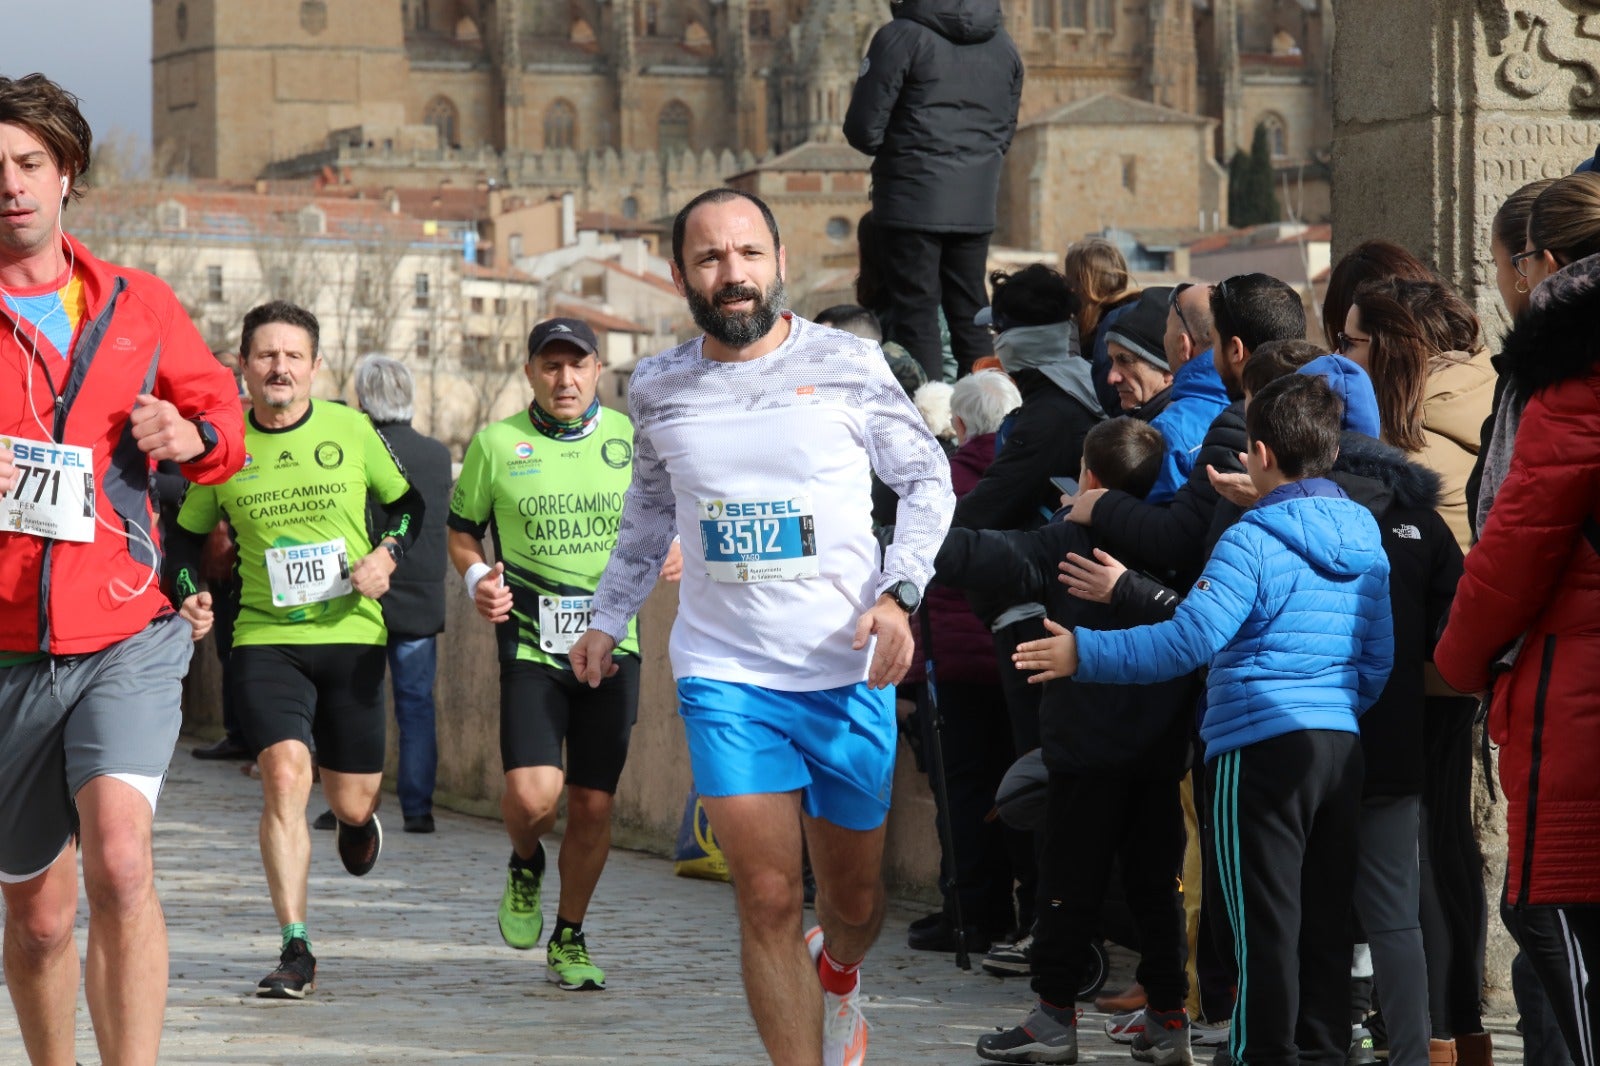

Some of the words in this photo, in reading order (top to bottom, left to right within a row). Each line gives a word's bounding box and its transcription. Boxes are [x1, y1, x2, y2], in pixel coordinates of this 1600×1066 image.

[13, 444, 85, 468] SETEL
[2, 464, 61, 506] 771
[236, 483, 347, 507] CORRECAMINOS
[18, 501, 36, 511] FER
[249, 498, 337, 520] CARBAJOSA
[725, 500, 801, 517] SETEL
[265, 514, 328, 529] SALAMANCA
[717, 519, 782, 555] 3512
[288, 544, 339, 560] SETEL
[286, 559, 325, 585] 1216
[561, 599, 593, 609] SET
